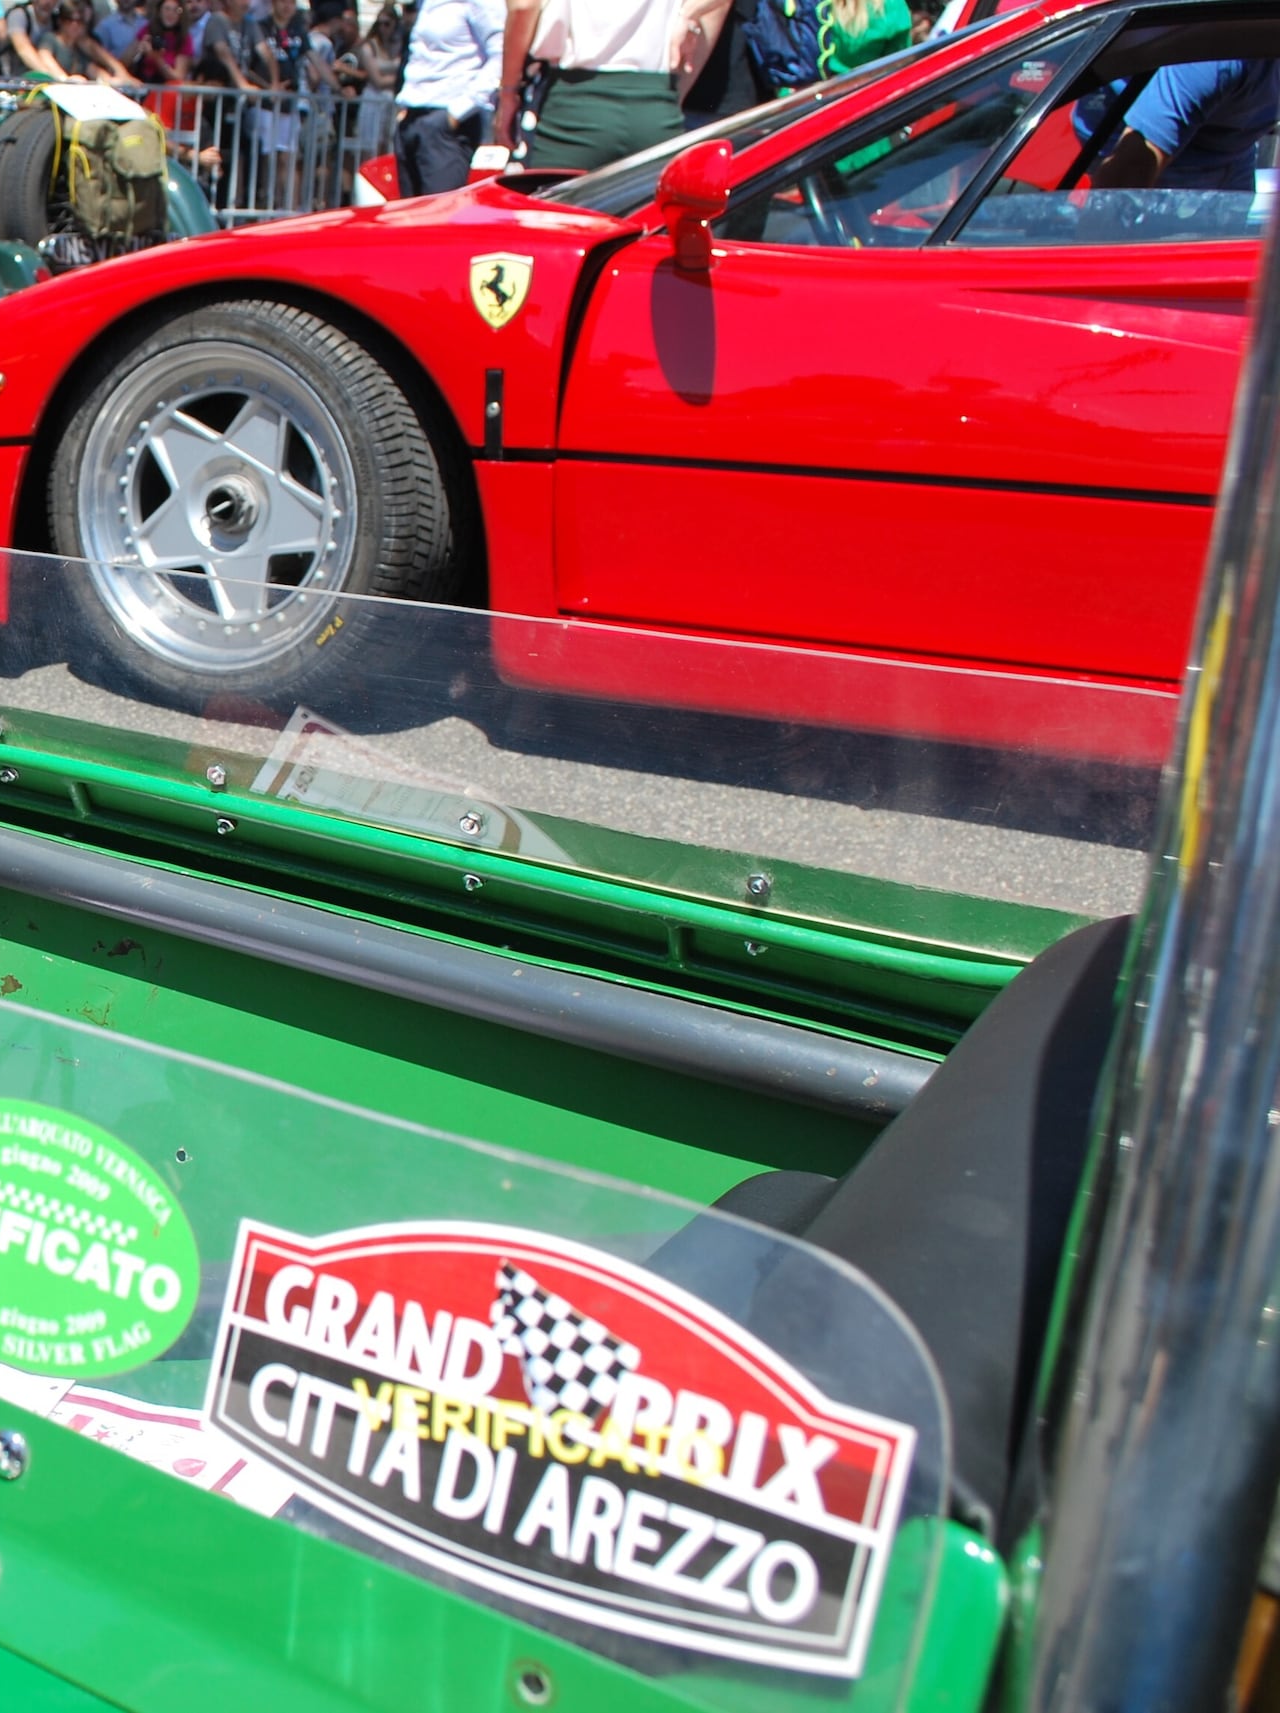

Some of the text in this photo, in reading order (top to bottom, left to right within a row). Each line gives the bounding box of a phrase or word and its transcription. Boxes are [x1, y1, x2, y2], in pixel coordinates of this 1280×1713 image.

[0, 1142, 63, 1177] giugno
[64, 1163, 111, 1203] 2009
[94, 1143, 172, 1228] VERNASCA
[1, 1331, 86, 1366] SILVER
[90, 1319, 153, 1362] FLAG
[64, 1308, 108, 1337] 2009
[264, 1264, 840, 1516] GRAND PRIX
[350, 1376, 726, 1488] VERIFICATO
[432, 1431, 517, 1534] DI
[514, 1478, 820, 1625] AREZZO
